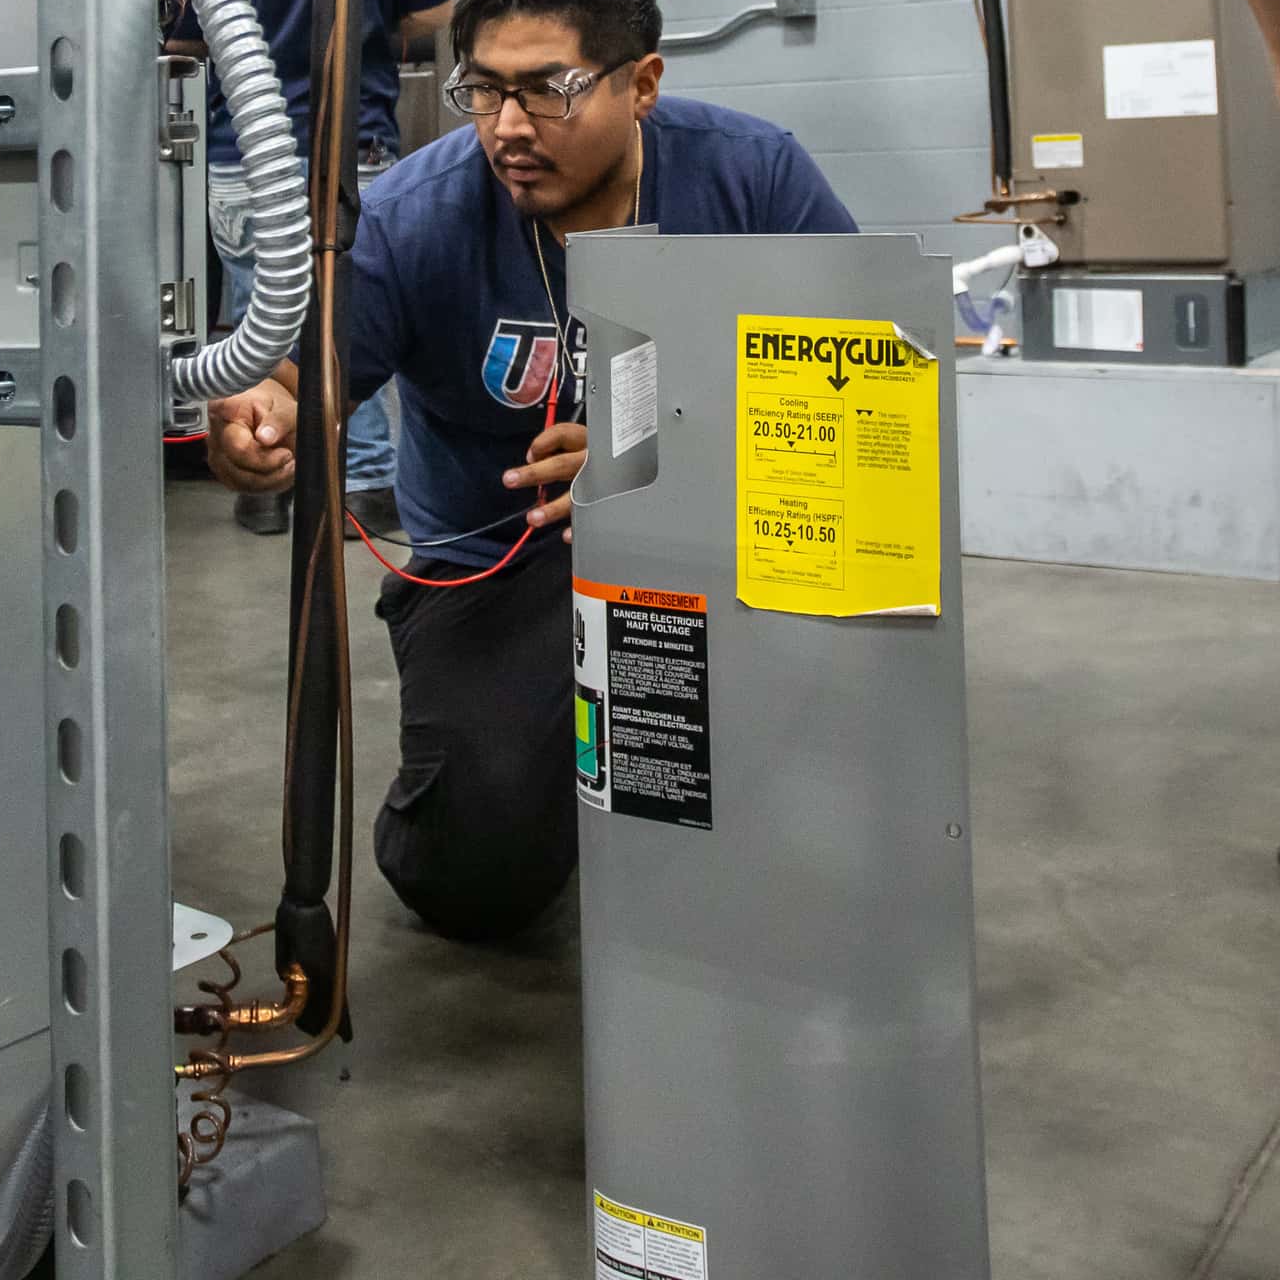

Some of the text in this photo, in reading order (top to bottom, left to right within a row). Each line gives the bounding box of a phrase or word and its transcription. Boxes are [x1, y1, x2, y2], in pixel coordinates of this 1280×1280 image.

[780, 398, 808, 409] Cooling
[749, 408, 784, 420] Efficiency
[787, 410, 810, 422] Rating
[753, 420, 836, 442] 20.50-21.00
[780, 498, 808, 510] Heating
[749, 506, 784, 519] Efficiency
[787, 510, 811, 522] Rating
[754, 520, 836, 543] 10.25-10.50
[633, 590, 699, 608] AVERTISSEMENT
[613, 609, 648, 621] DANGER
[626, 620, 690, 636] HAUT VOLTAGE
[604, 1203, 637, 1222] CAUTION
[656, 1221, 700, 1239] ATTENTION
